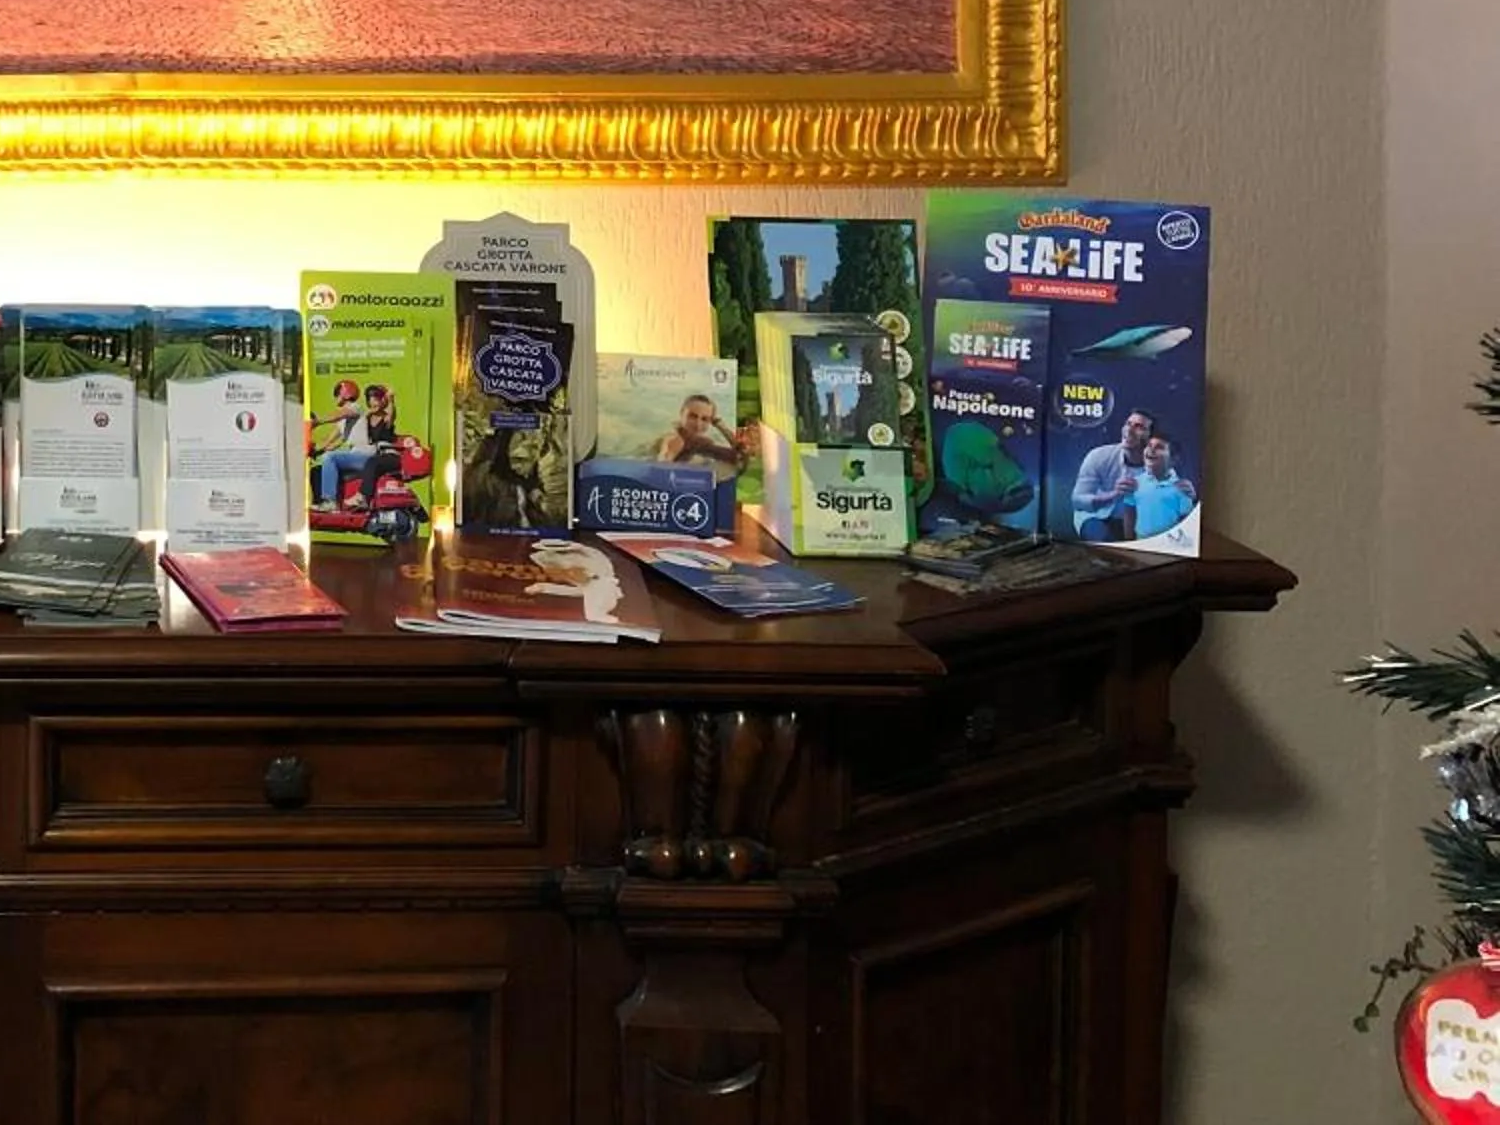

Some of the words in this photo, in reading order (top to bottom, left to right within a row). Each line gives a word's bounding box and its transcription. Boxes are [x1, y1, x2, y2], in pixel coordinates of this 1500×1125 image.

[482, 236, 529, 248] PARCO
[477, 249, 534, 260] GROTTA
[984, 232, 1057, 275] SEA
[443, 261, 507, 272] CASCATA
[509, 262, 567, 274] VARONE
[1038, 284, 1108, 298] ANNIVERSARIO
[500, 342, 541, 356] PARCO
[949, 333, 987, 356] SEA
[493, 354, 543, 369] GROTTA
[489, 365, 543, 381] CASCATA
[491, 378, 541, 394] VARONE
[1063, 384, 1105, 401] NEW
[933, 394, 1035, 420] Napoleone
[1063, 402, 1104, 418] 2018
[611, 487, 669, 502] SCONTO
[816, 491, 893, 513] Sigurtà
[611, 498, 669, 510] DISCOUNT
[611, 507, 668, 521] RABATT
